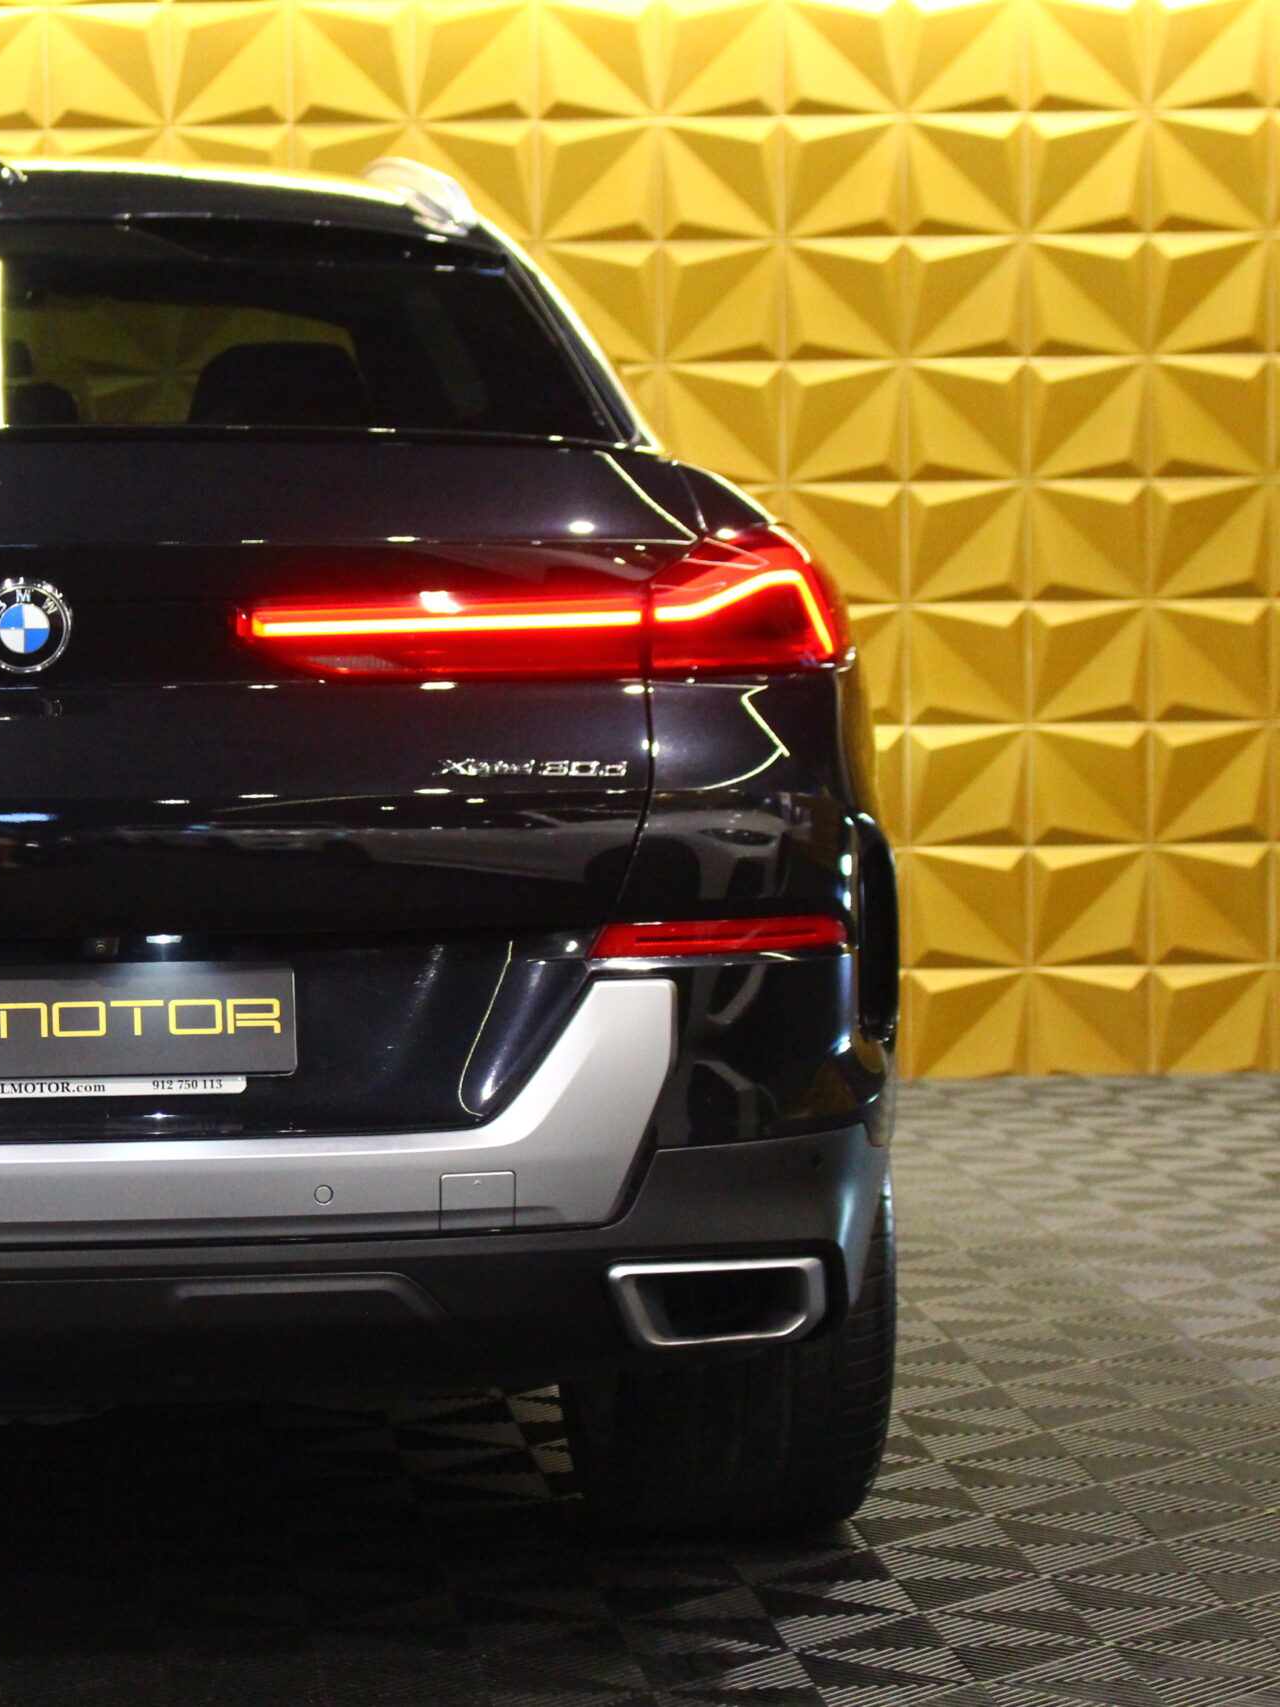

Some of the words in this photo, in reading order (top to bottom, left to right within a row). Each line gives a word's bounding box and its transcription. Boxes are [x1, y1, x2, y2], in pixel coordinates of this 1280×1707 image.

[152, 1079, 174, 1090] 912
[177, 1079, 199, 1090] 750
[202, 1078, 223, 1089] 113
